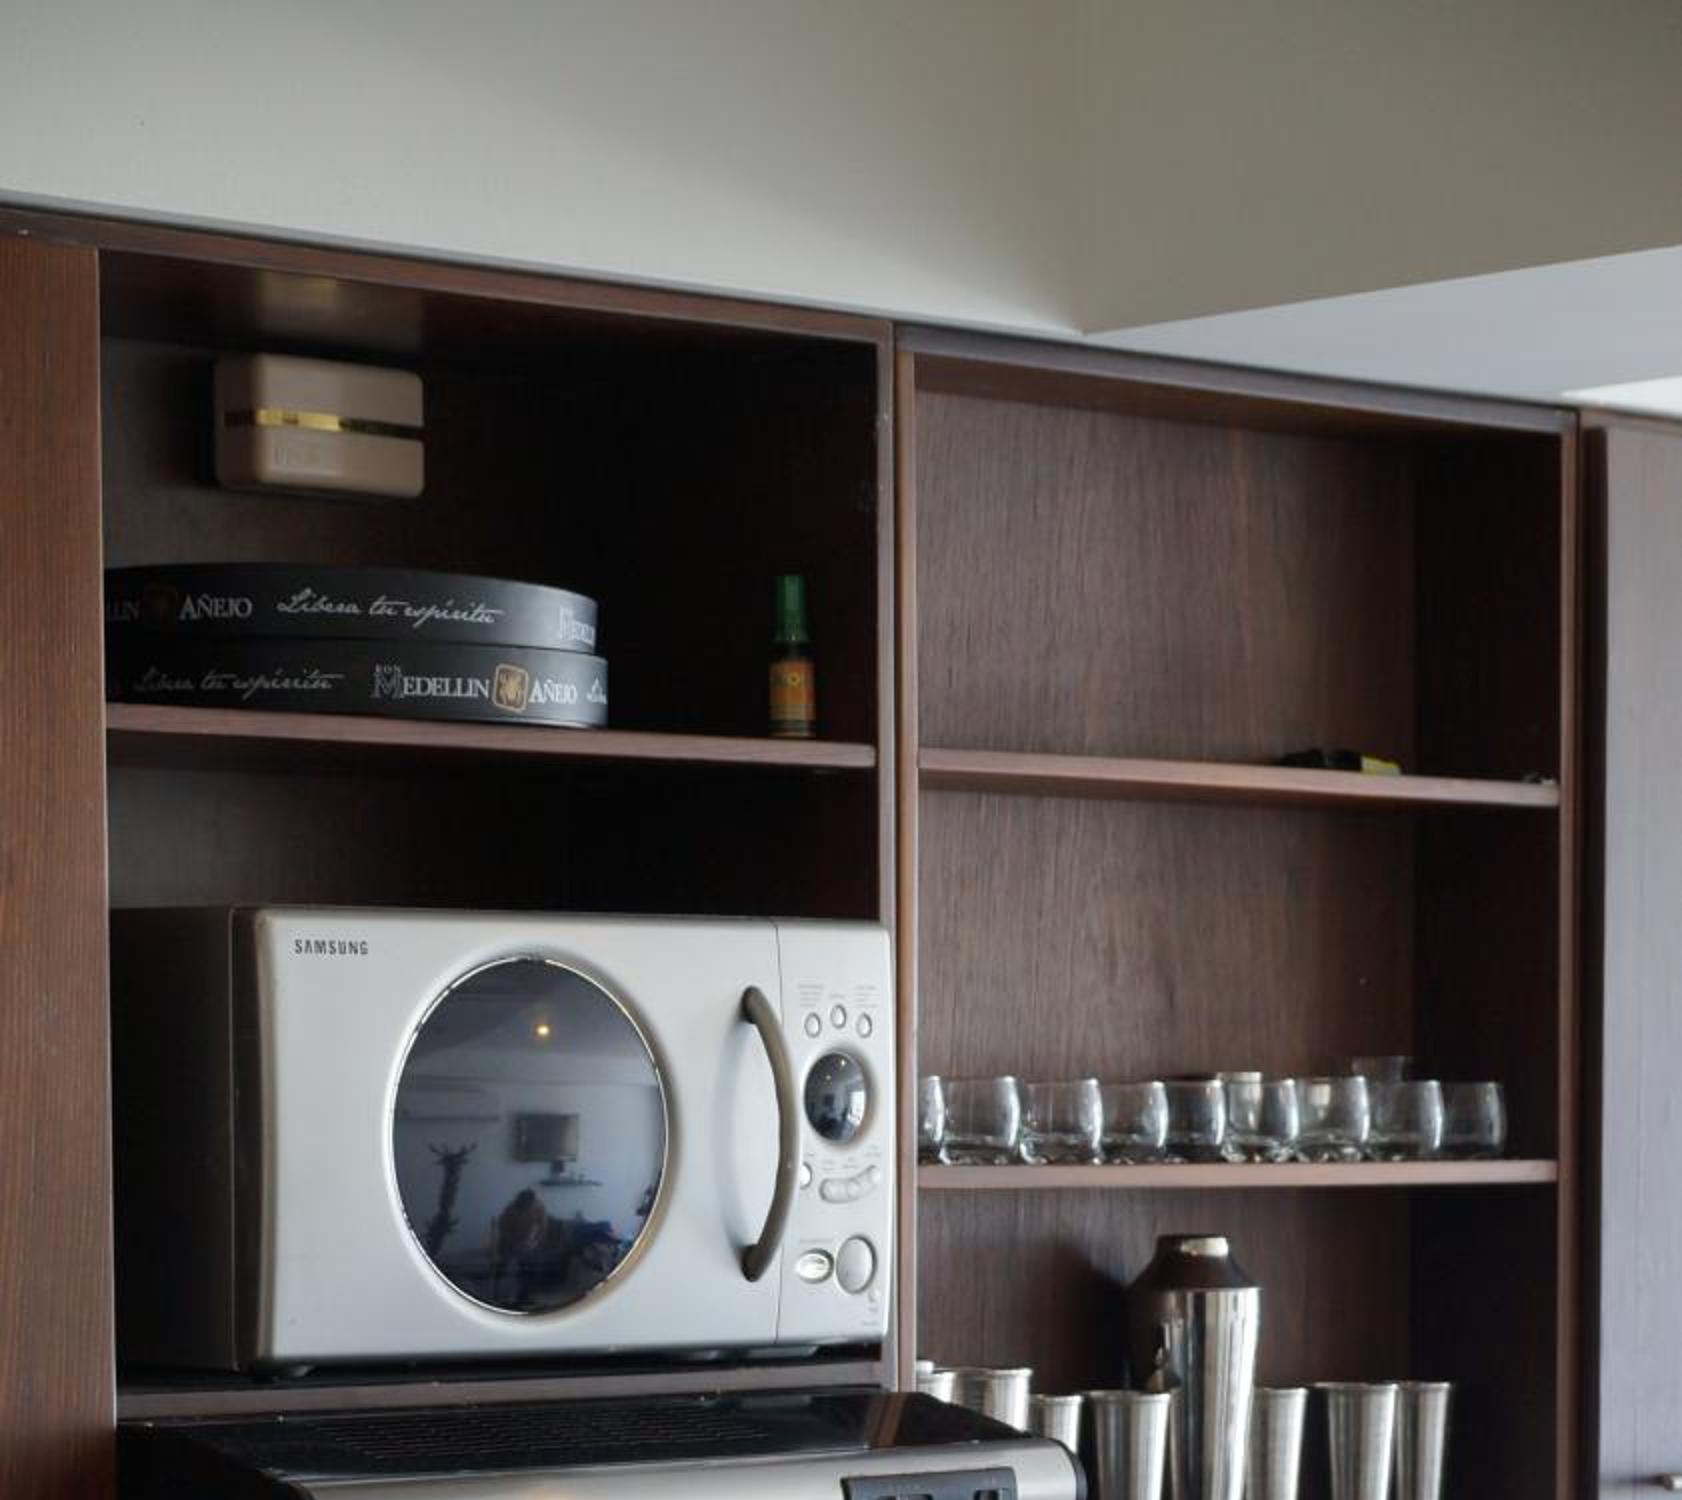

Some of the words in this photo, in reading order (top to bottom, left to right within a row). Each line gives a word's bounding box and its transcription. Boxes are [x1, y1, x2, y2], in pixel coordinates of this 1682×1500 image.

[179, 593, 254, 620] AÑEJO
[277, 587, 360, 614] Libera
[369, 595, 409, 615] tu
[372, 672, 490, 699] MEDELLIN
[528, 679, 578, 704] AÑEJO
[294, 939, 369, 955] SAMSUNG
